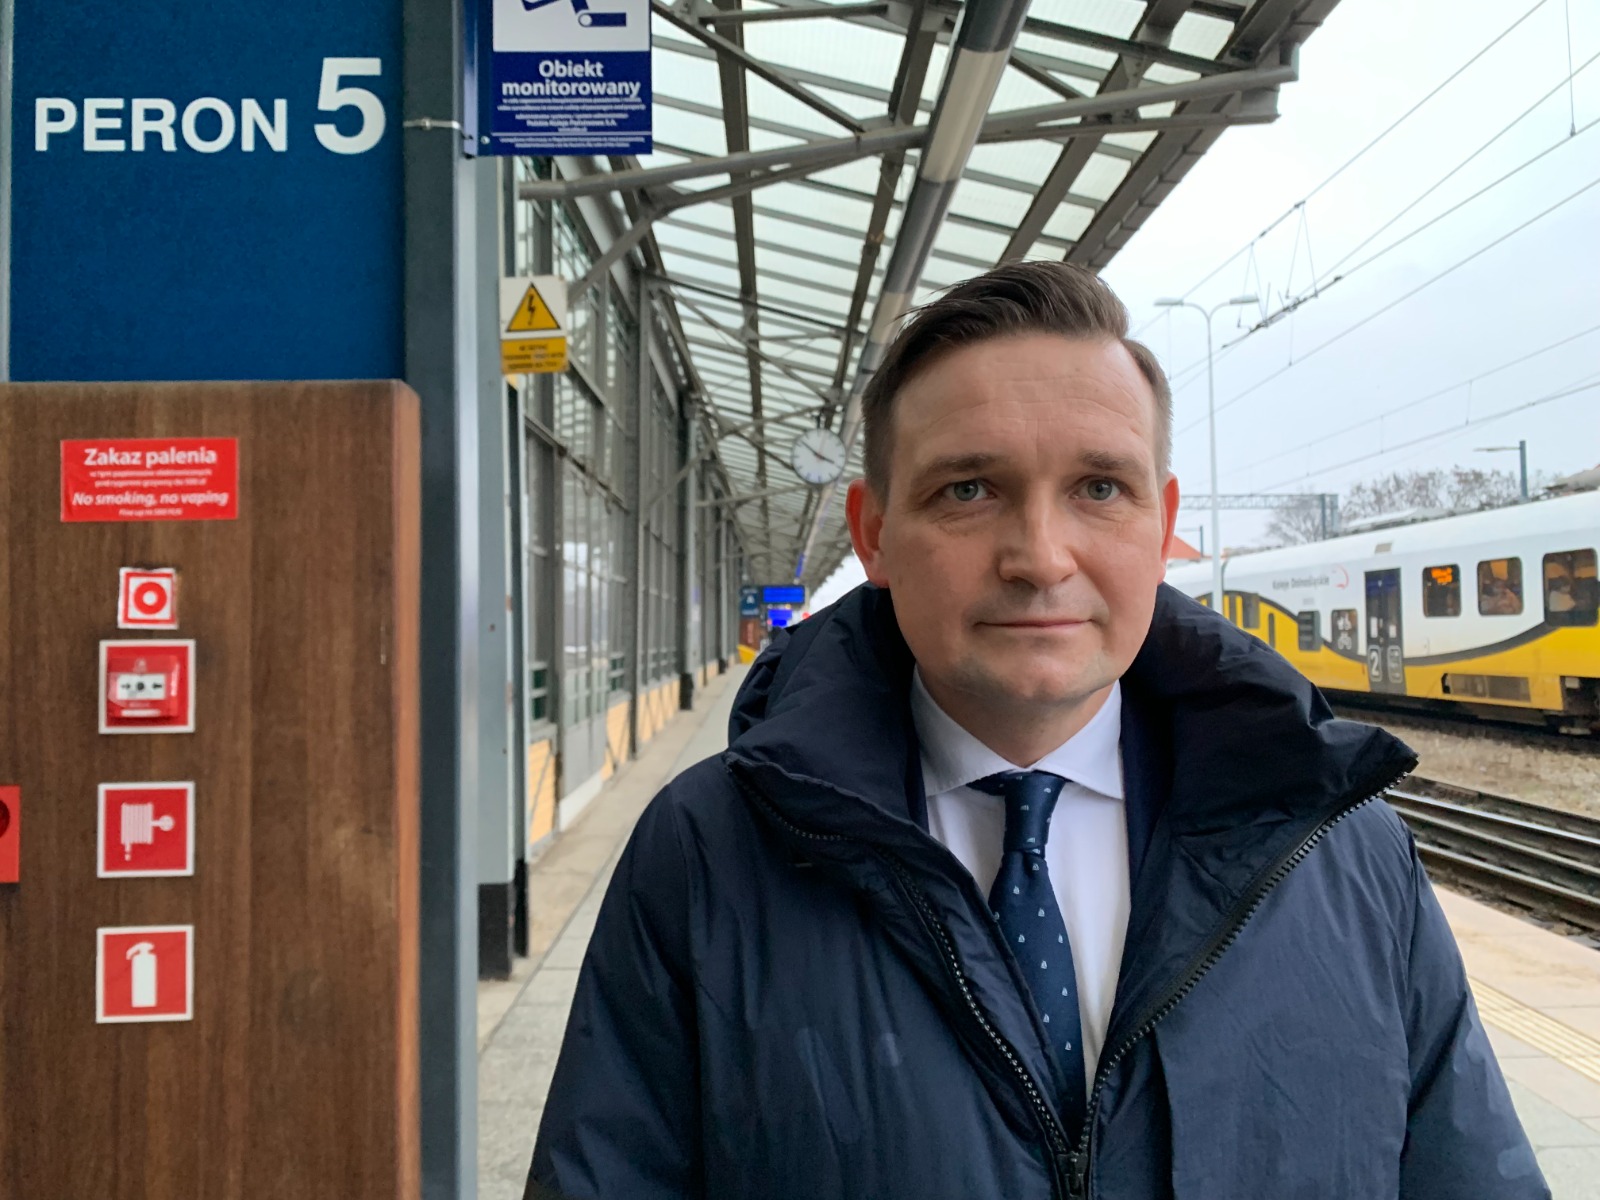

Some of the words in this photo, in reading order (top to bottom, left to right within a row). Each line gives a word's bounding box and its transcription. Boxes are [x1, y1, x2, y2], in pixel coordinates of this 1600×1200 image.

[538, 59, 605, 78] Obiekt
[502, 79, 641, 98] monitorowany
[34, 97, 288, 153] PERON
[313, 57, 386, 155] 5
[84, 447, 142, 466] Zakaz
[145, 446, 217, 469] palenia
[72, 492, 94, 506] No
[95, 491, 158, 508] smoking,
[160, 493, 179, 505] no
[181, 490, 229, 507] vaping
[1370, 650, 1380, 677] 2
